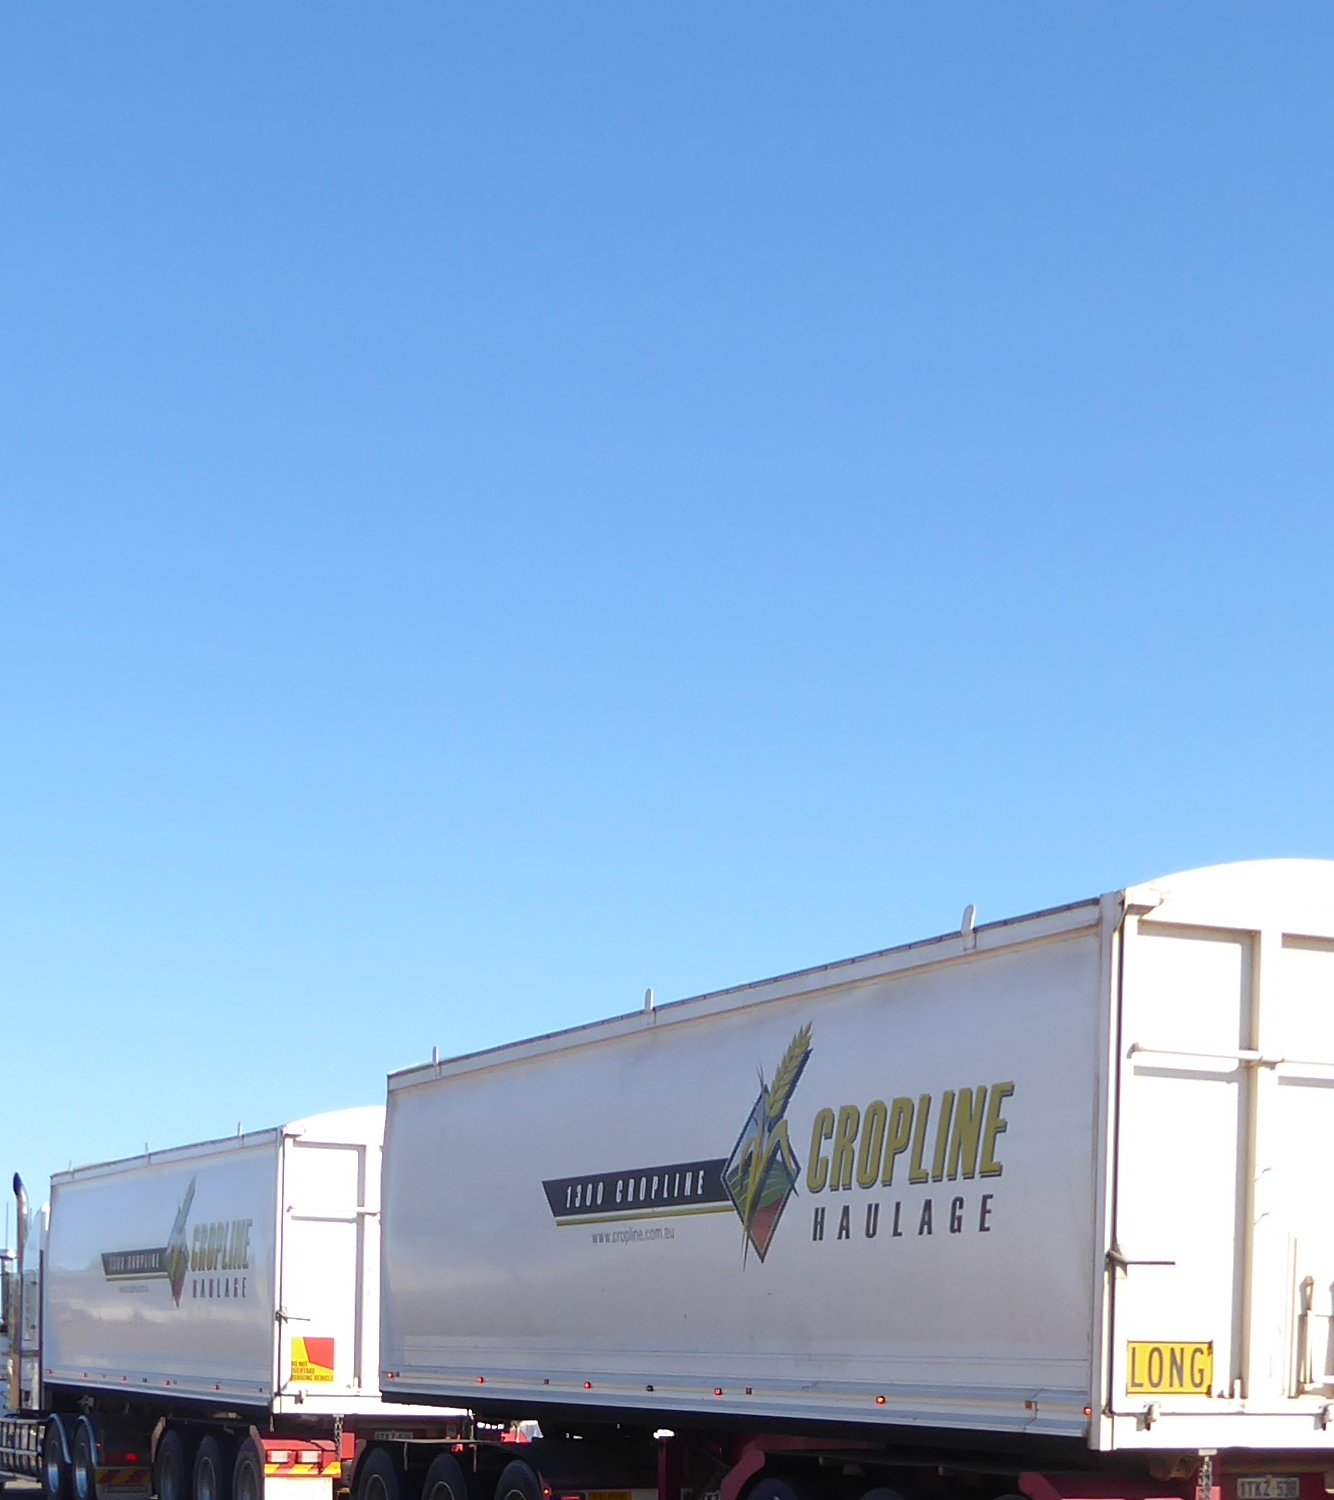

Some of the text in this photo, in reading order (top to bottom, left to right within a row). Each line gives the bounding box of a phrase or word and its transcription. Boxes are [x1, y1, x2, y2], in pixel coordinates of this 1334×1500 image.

[806, 1081, 1015, 1194] CROPLINE
[566, 1170, 705, 1208] 1300 CROPLINE
[592, 1227, 675, 1245] www.cropline.com.au
[812, 1194, 994, 1241] HAULAGE
[192, 1277, 247, 1298] HAULAGE
[1131, 1347, 1204, 1388] LONG
